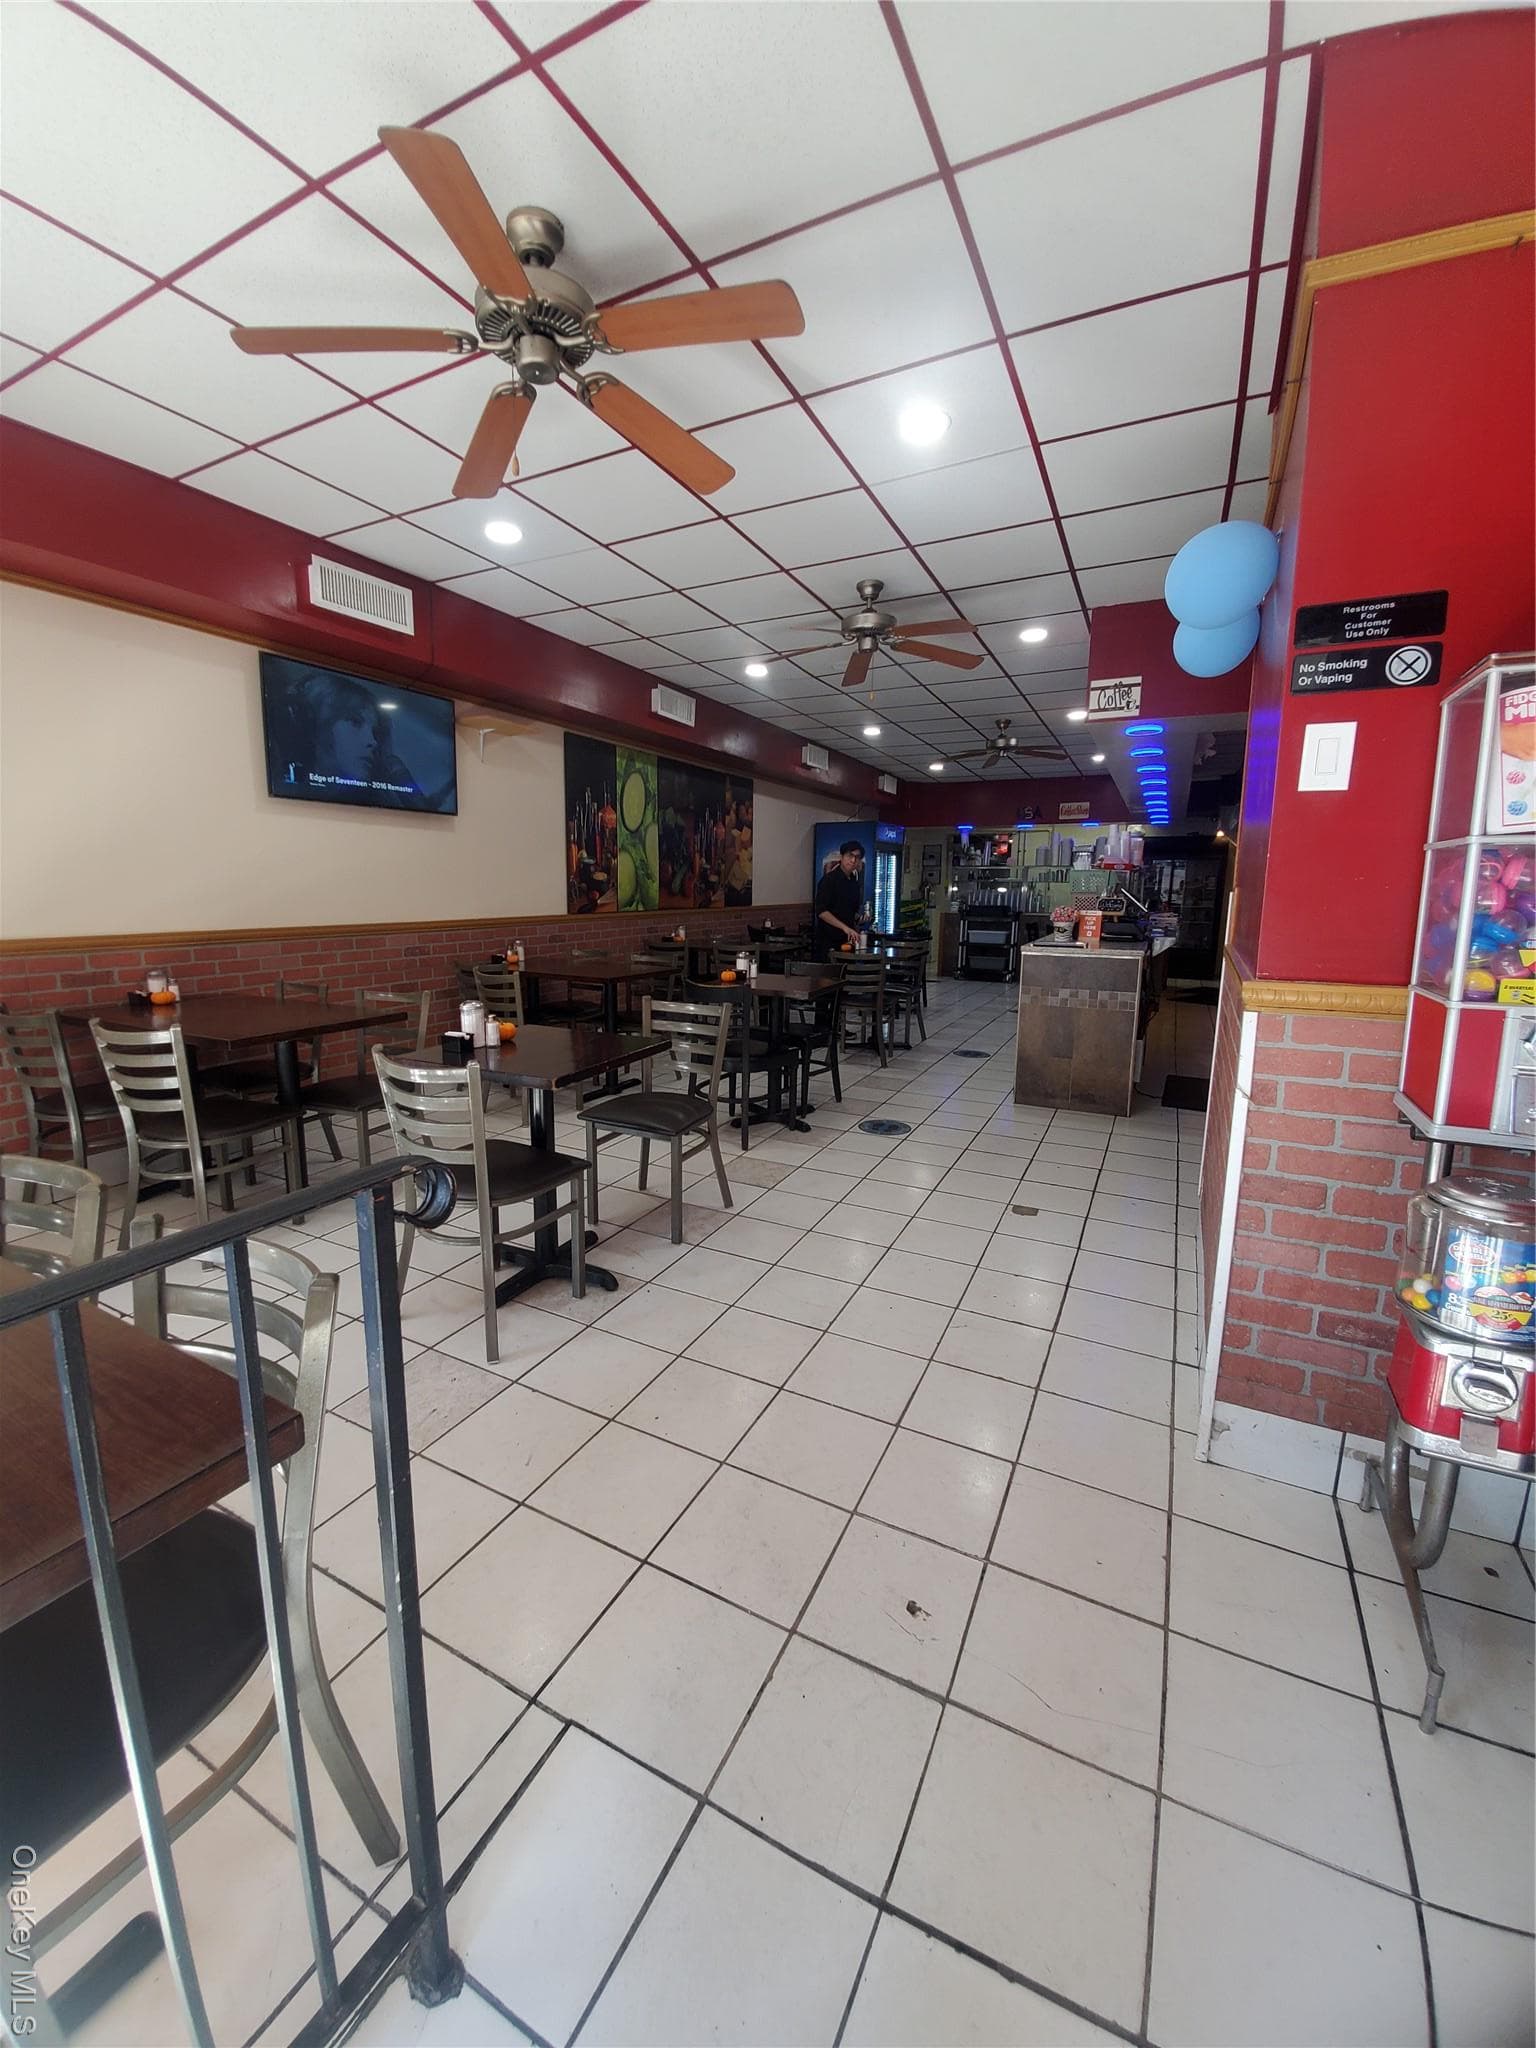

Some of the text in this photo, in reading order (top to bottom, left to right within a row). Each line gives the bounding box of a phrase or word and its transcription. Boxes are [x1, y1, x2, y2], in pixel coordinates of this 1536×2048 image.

[1343, 601, 1395, 614] Restrooms
[1360, 612, 1377, 620] For
[1344, 618, 1392, 630] Customer
[1345, 627, 1390, 639] Use Only
[1299, 658, 1368, 673] No Smoking
[1298, 673, 1353, 686] Or Vaping
[1097, 682, 1133, 710] Coffee
[309, 773, 326, 783] Edge
[335, 777, 368, 787] Seventeen
[387, 783, 413, 793] Remaster
